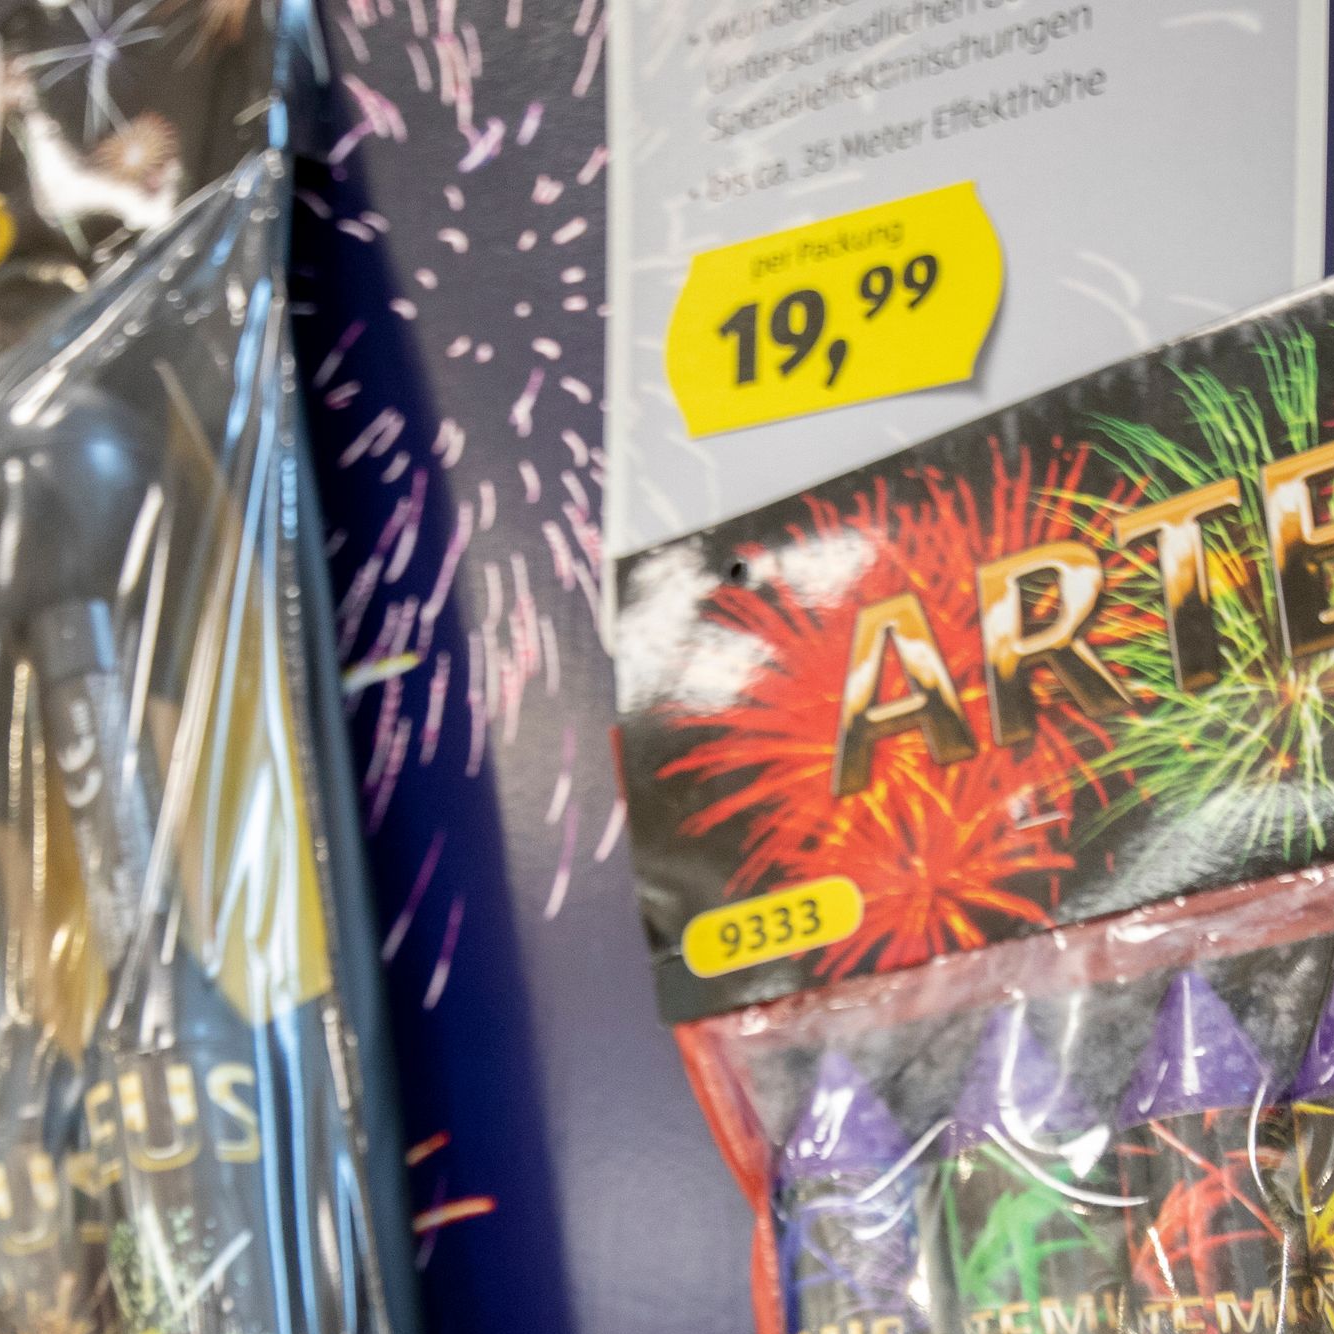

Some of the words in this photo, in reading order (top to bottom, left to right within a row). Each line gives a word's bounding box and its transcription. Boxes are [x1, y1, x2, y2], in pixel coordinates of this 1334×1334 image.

[840, 117, 929, 165] Meter
[717, 253, 939, 388] 19,99
[719, 898, 822, 958] 9333
